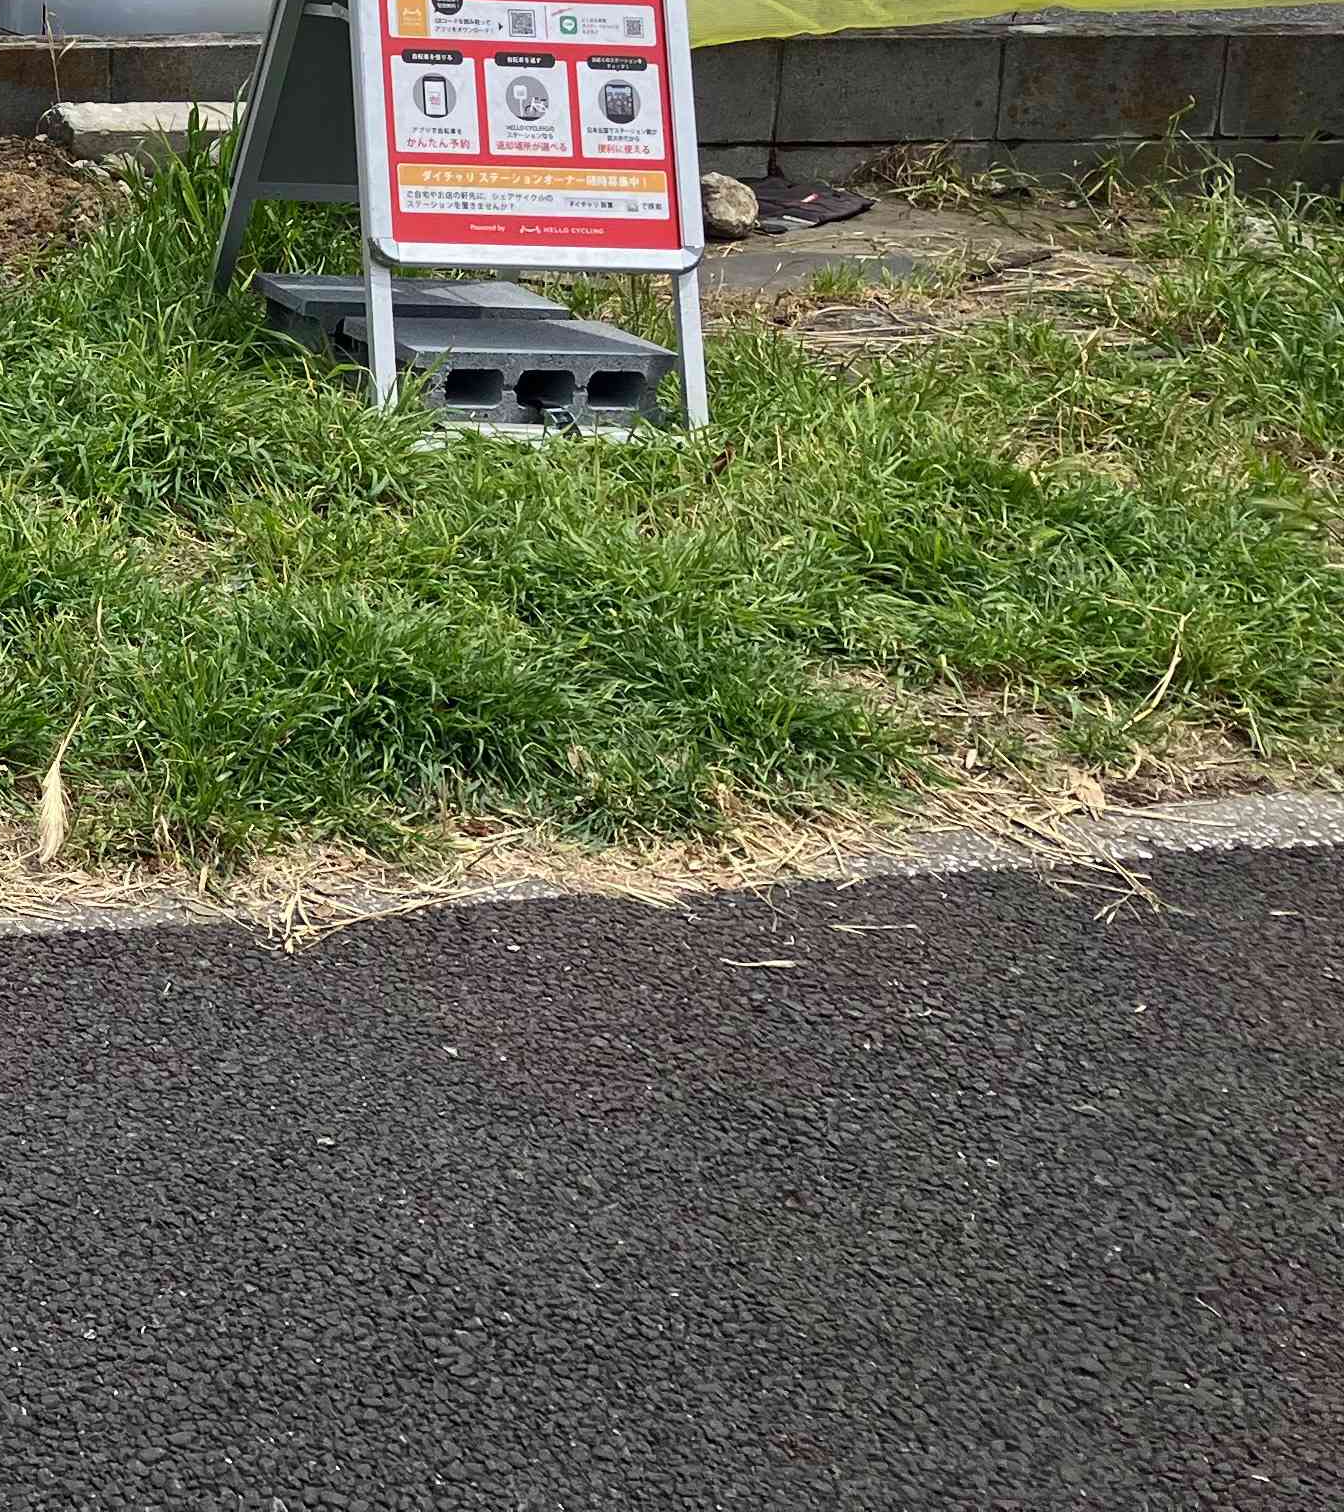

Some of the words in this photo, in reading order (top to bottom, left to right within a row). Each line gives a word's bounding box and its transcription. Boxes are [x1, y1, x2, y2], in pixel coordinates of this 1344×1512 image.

[407, 137, 471, 149] かんたん予約
[422, 171, 474, 182] ダイチャリ
[543, 226, 569, 234] HELLO
[571, 227, 604, 235] CYCLING
